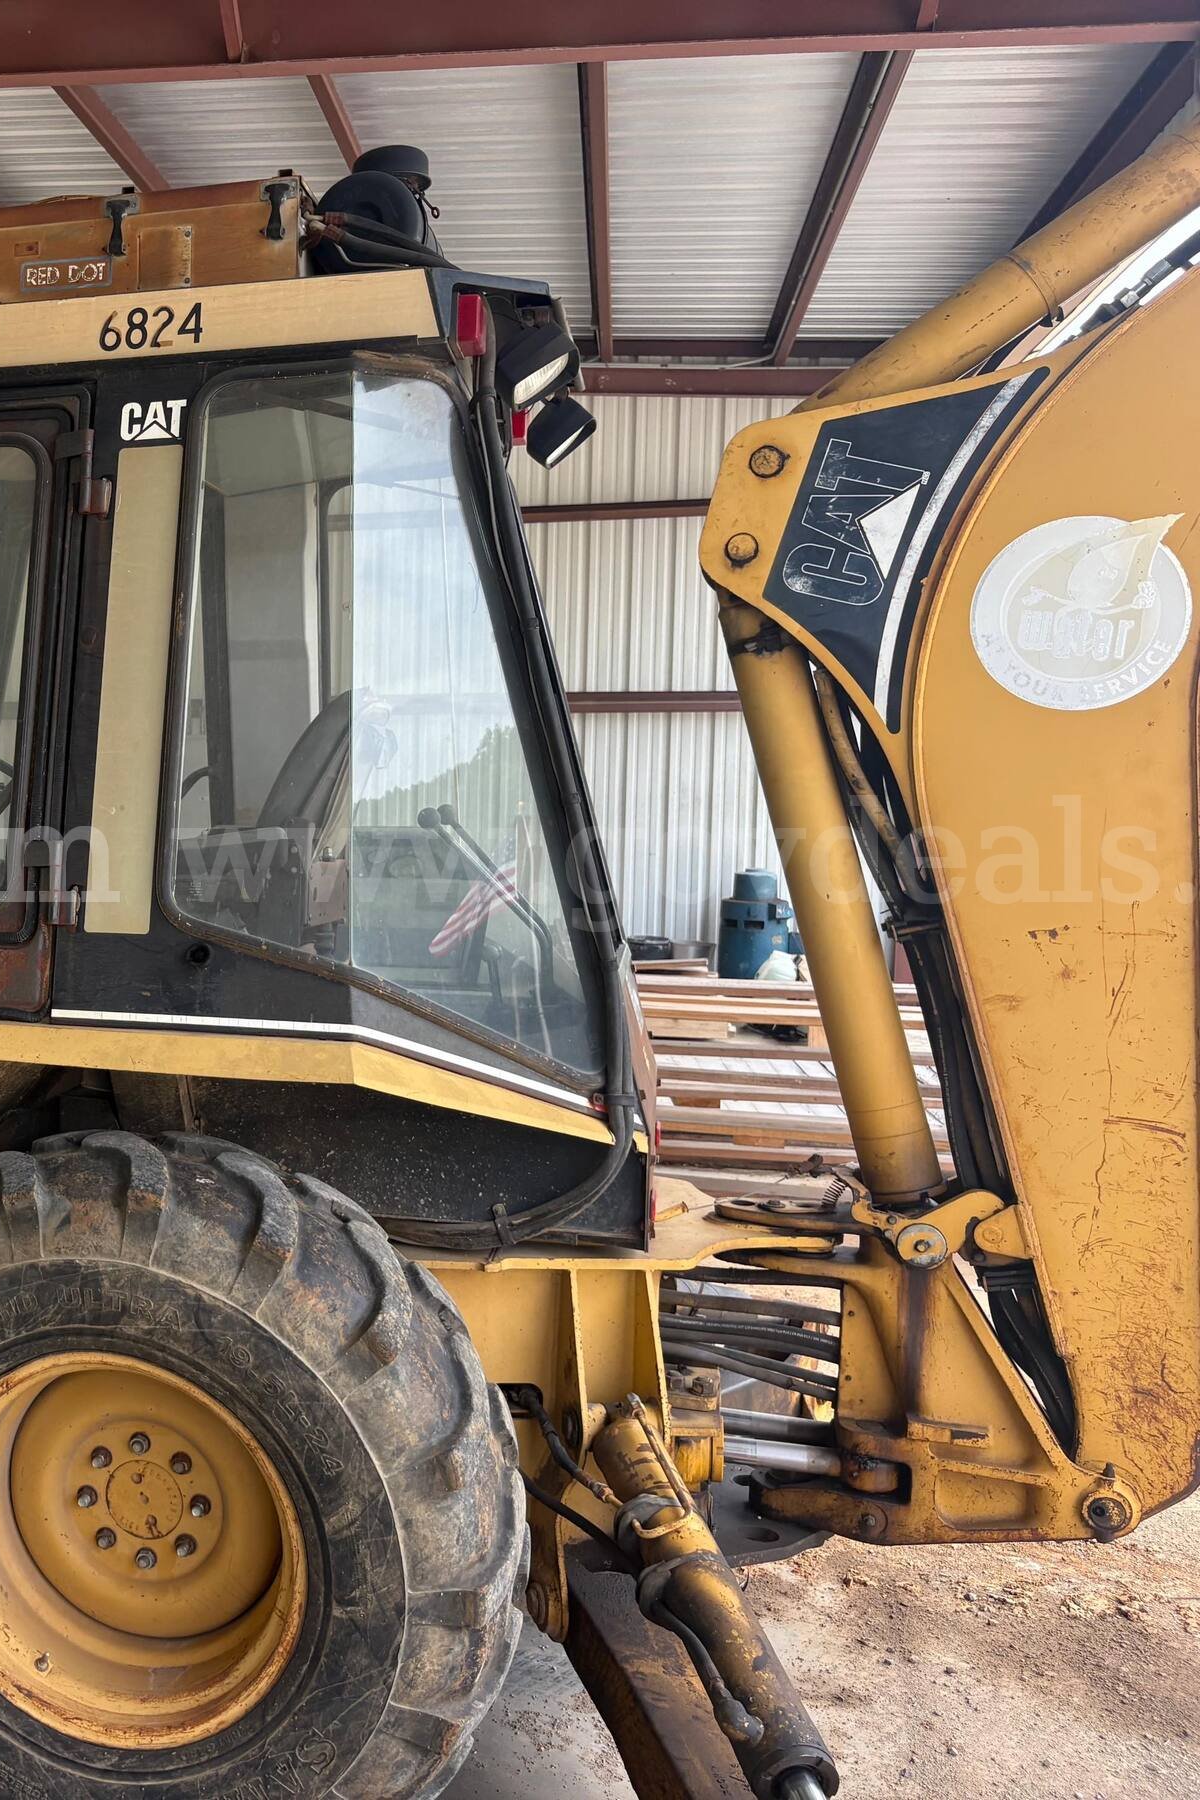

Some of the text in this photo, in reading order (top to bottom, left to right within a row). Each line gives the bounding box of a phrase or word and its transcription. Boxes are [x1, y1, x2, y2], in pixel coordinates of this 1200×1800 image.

[26, 262, 106, 286] RED DOT
[99, 302, 203, 352] 6824
[120, 399, 188, 441] CAT
[782, 438, 928, 606] CAT
[1080, 640, 1173, 701] SERVICE
[55, 1286, 183, 1332] ULTRA
